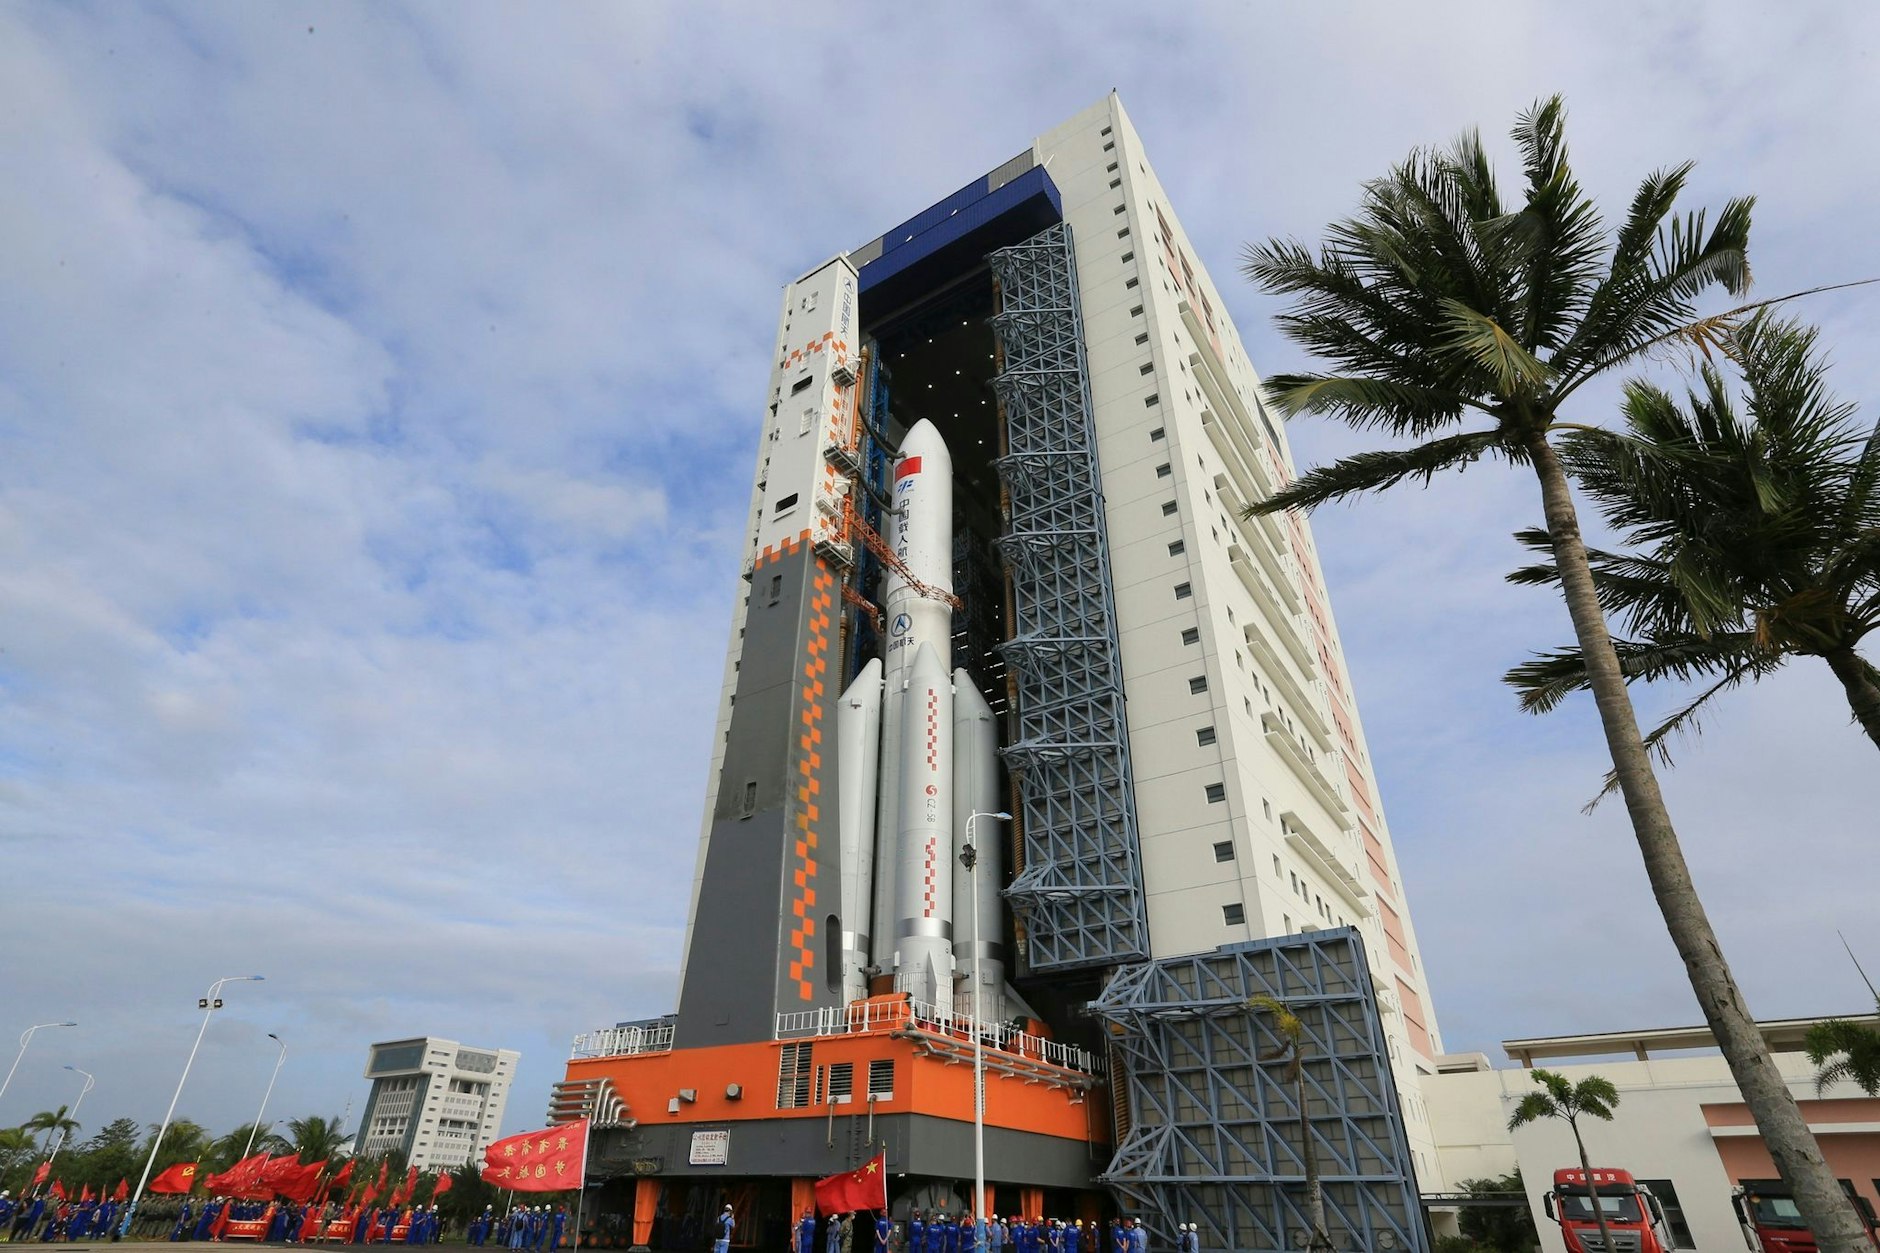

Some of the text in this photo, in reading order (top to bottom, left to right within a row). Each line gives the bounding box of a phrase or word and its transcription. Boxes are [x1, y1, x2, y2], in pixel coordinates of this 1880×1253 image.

[889, 636, 915, 652] 中国航天
[927, 798, 936, 823] CZ-5B
